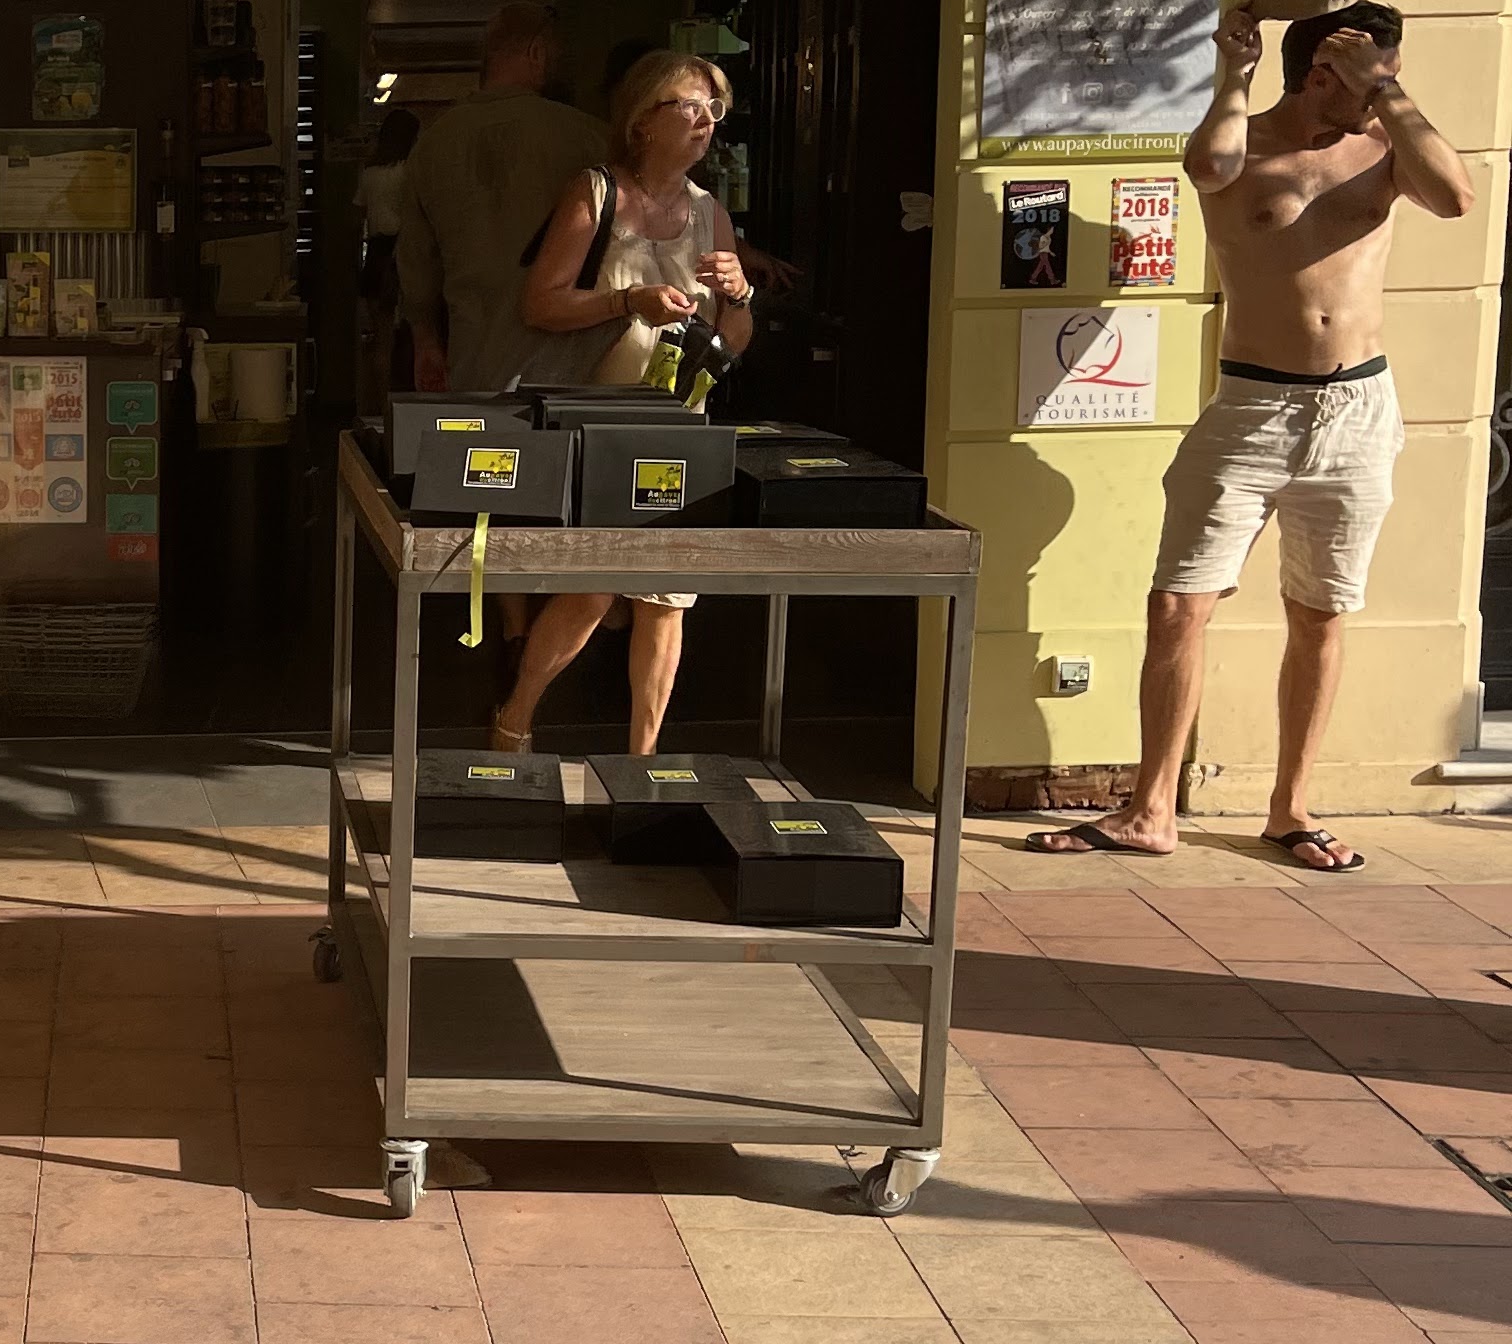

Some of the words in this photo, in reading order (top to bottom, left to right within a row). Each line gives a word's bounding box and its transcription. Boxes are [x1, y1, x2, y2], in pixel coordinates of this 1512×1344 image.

[1012, 208, 1061, 223] 2018
[1121, 197, 1170, 218] 2018
[1113, 236, 1175, 262] petit
[1122, 257, 1175, 276] futé
[50, 372, 78, 385] 2015
[1035, 391, 1139, 408] QUALITÉ
[1037, 407, 1139, 420] TOURISME
